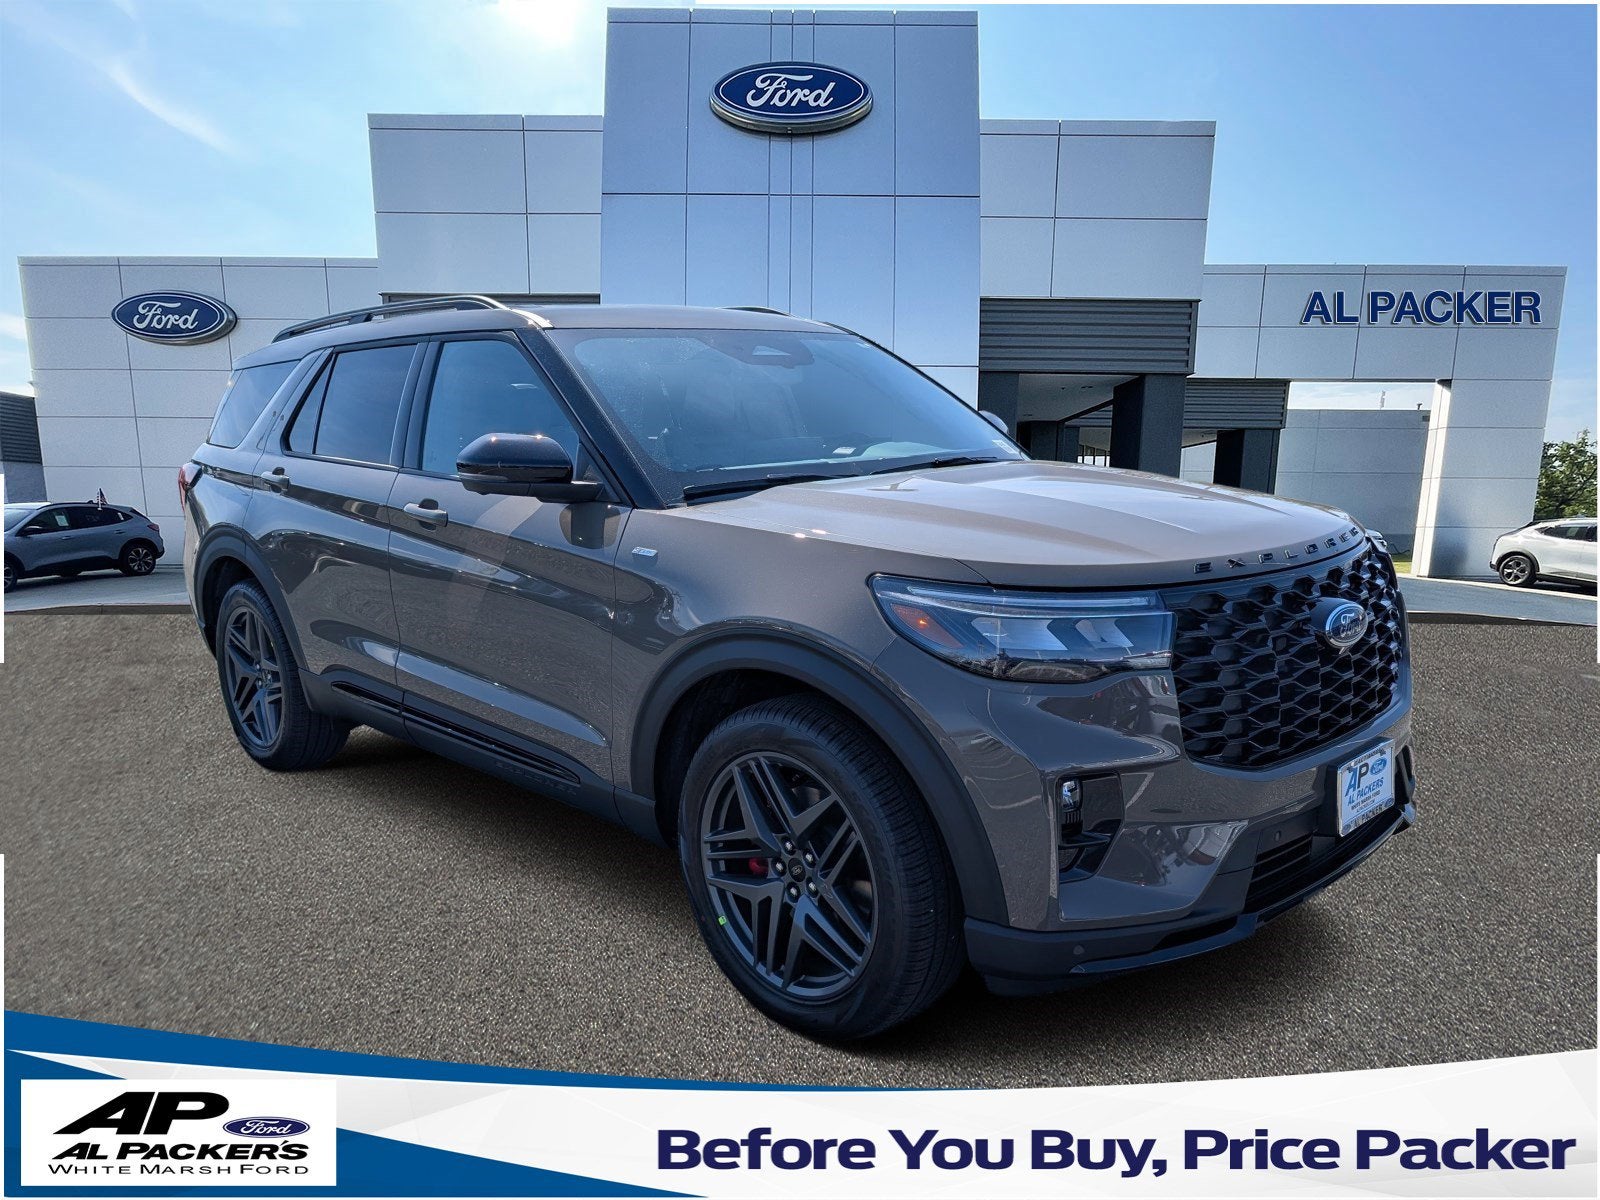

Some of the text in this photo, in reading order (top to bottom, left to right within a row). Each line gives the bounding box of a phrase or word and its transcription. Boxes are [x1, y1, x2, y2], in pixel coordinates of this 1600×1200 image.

[746, 73, 836, 107] Ford
[133, 300, 199, 330] Ford
[1301, 289, 1542, 325] AL PACKER
[1193, 526, 1360, 574] EXPLORER
[1344, 762, 1369, 797] AP
